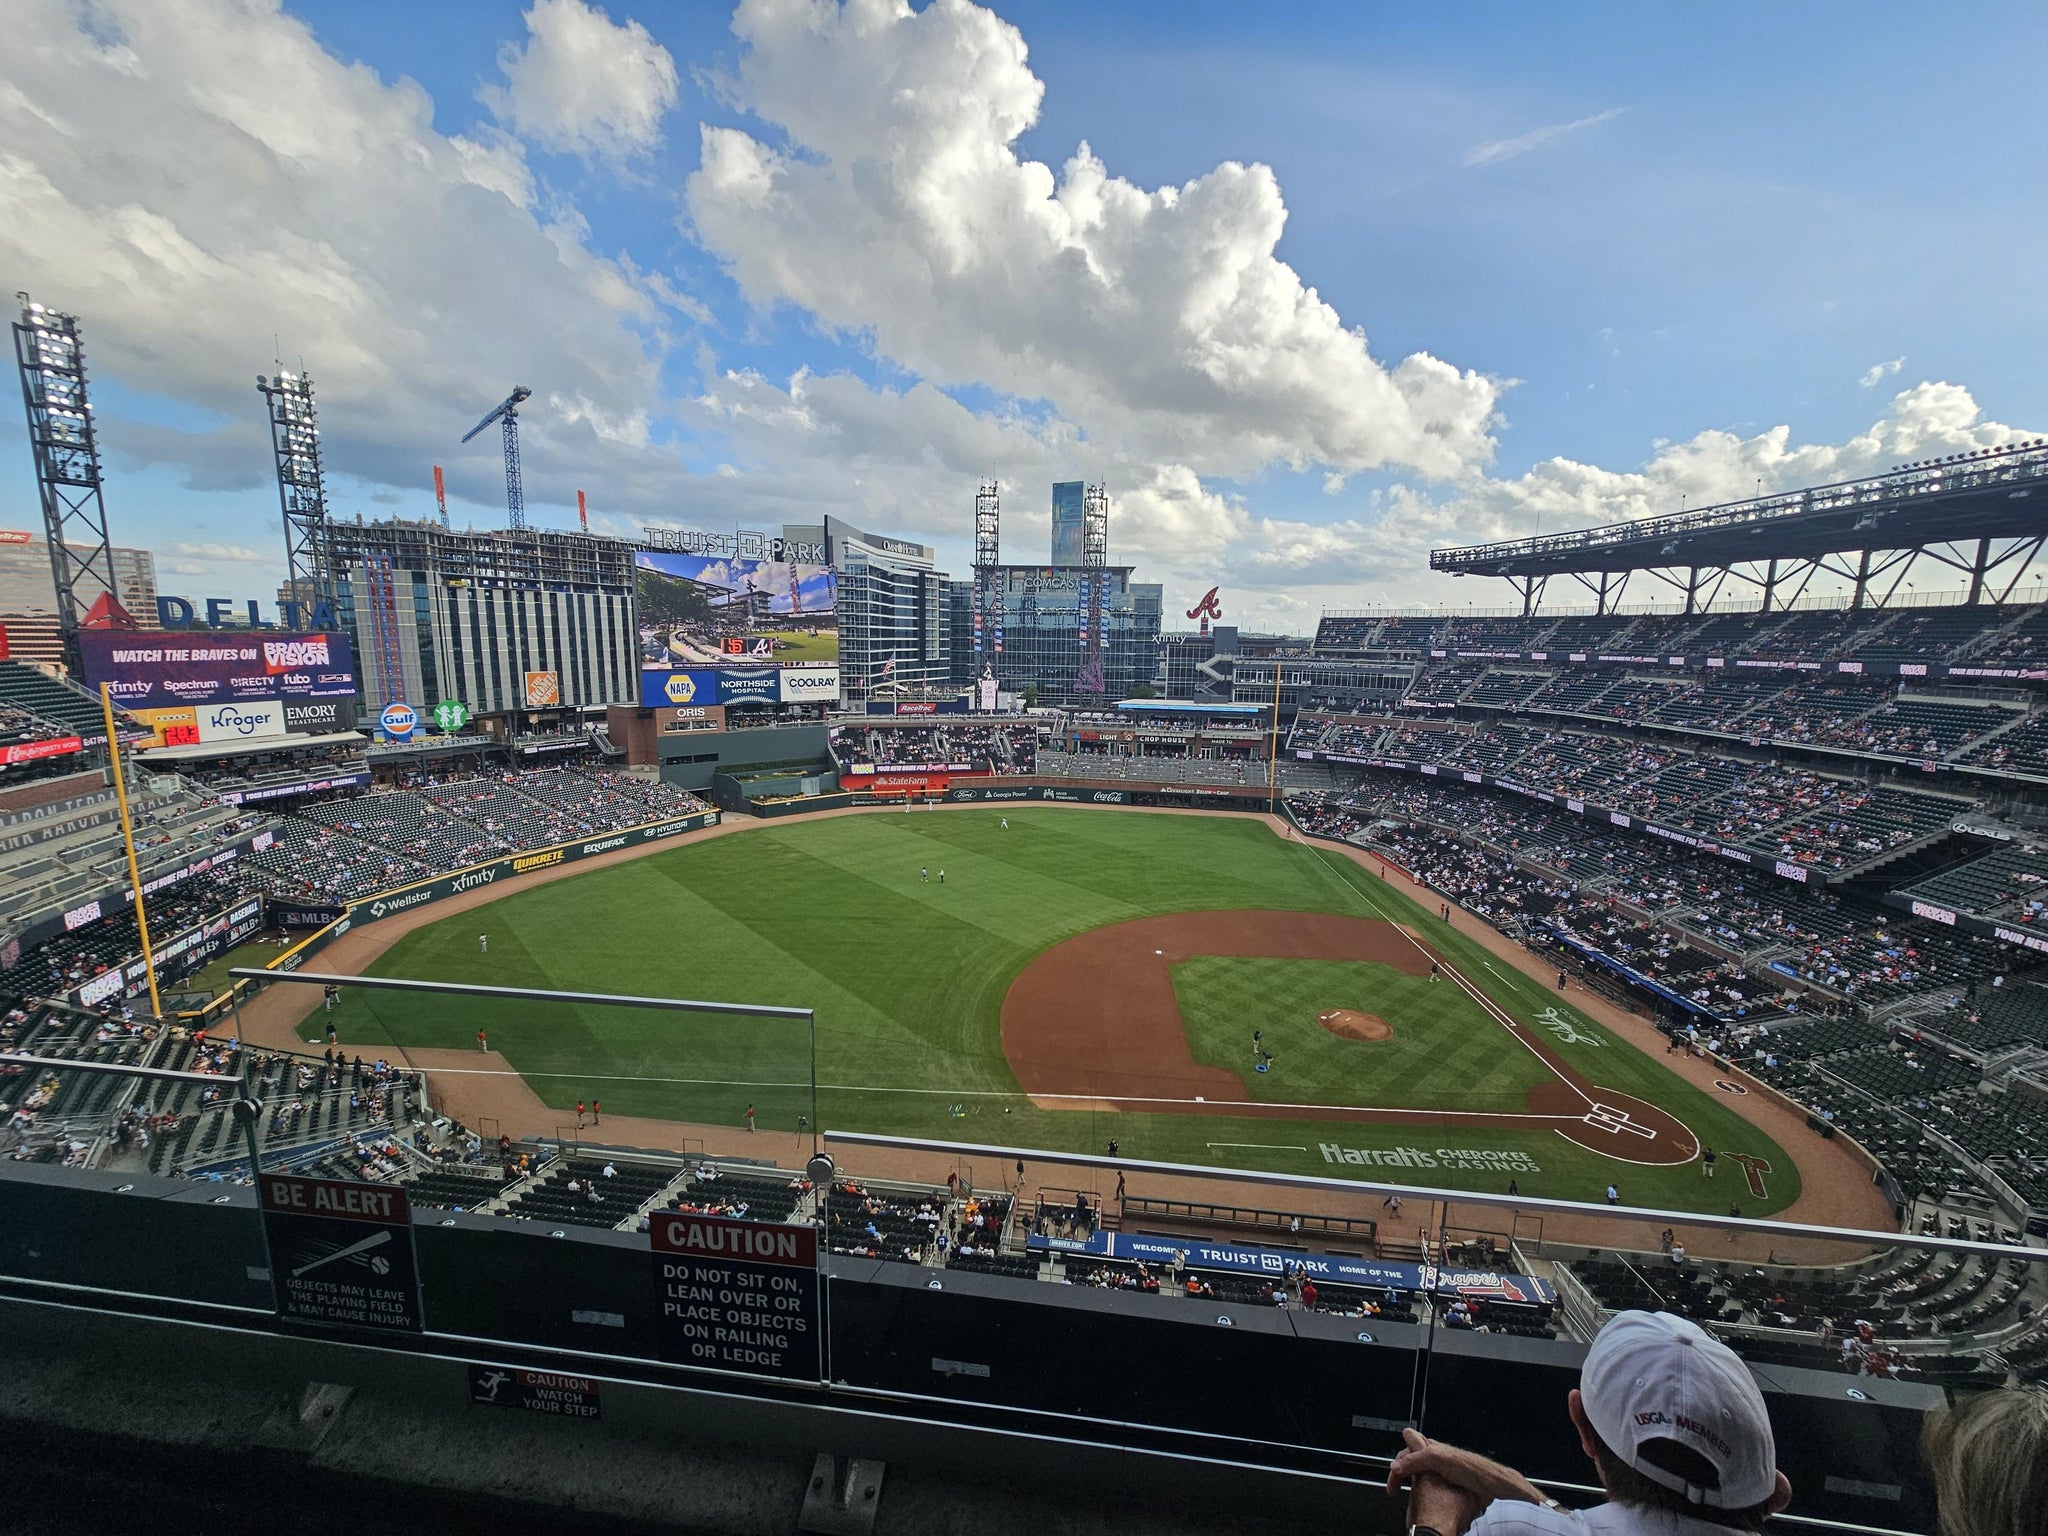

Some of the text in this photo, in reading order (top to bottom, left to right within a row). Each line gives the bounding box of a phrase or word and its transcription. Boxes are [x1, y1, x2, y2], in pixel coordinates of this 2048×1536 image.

[644, 528, 824, 561] TRUIST PARK
[1025, 577, 1081, 590] COMCAST
[156, 596, 339, 629] DELTA
[1151, 633, 1187, 645] xfinity
[113, 649, 257, 662] WATCH THE BRAVES ON
[264, 642, 328, 655] BRAVES
[265, 653, 329, 666] VISION
[164, 680, 219, 691] Spectrum
[230, 677, 274, 687] DIRECTV
[283, 674, 310, 685] fubo
[721, 680, 775, 688] NORTHSIDE
[789, 678, 836, 687] COOLRAY
[670, 683, 692, 695] NAPA
[211, 707, 270, 734] Kroger
[286, 705, 336, 719] EMORY
[384, 713, 415, 725] Gulf
[677, 708, 705, 717] ORIS
[288, 717, 336, 725] HEALTHCARE
[331, 777, 357, 787] BASEBALL
[657, 821, 688, 834] HYUNDAI
[1968, 827, 2010, 841] LEXUS
[584, 837, 626, 854] EQUIFAX
[1646, 825, 1658, 834] YOUR
[1659, 828, 1670, 838] NEW
[1670, 831, 1686, 843] HOME
[1686, 836, 1697, 846] FOR
[1722, 847, 1751, 862] BASEBALL
[513, 850, 563, 870] QUIKRETE
[1776, 861, 1807, 875] BRAVES
[125, 888, 143, 901] YOR
[144, 881, 159, 894] NEW
[159, 873, 177, 887] HOME
[177, 868, 188, 880] FOR
[212, 849, 237, 865] BASEBALL
[451, 869, 496, 892] xfinity
[1776, 867, 1806, 883] VISION
[388, 891, 431, 910] Wellstar
[64, 901, 99, 919] BRAVES
[302, 913, 337, 924] MLB+
[66, 908, 101, 930] VISION
[239, 918, 259, 935] MLB+
[167, 940, 188, 958] HOME
[188, 932, 202, 948] FOR
[230, 902, 259, 924] BASEBALL
[1994, 927, 2025, 944] YOUR
[1318, 1143, 1532, 1168] Harrah's CHEROKEE
[1442, 1159, 1541, 1172] CASINOS
[271, 1182, 392, 1216] BE ALERT
[667, 1222, 797, 1258] CAUTION
[1200, 1249, 1258, 1265] TRUIST
[1284, 1258, 1329, 1273] PARK
[1338, 1265, 1361, 1274] HOME
[1369, 1268, 1380, 1276] OF
[1383, 1270, 1402, 1278] THE
[1418, 1265, 1500, 1290] Braves
[663, 1264, 803, 1295] DO NOT SIT ON,
[287, 1279, 405, 1301] OBJECTS MAY LEAVE
[667, 1284, 800, 1312] LEAN OVER OR
[291, 1290, 403, 1313] THE PLAYING FIELD
[287, 1303, 411, 1327] & MAY CAUSE INJURY
[664, 1302, 807, 1332] PLACE OBJECTS
[683, 1324, 788, 1349] ON RAILING
[691, 1343, 783, 1367] OR LEDGE
[526, 1372, 589, 1391] CAUTION
[536, 1388, 583, 1403] WATCH
[524, 1398, 598, 1417] YOUR STEP
[1635, 1411, 1731, 1459] USGA MEMBER
